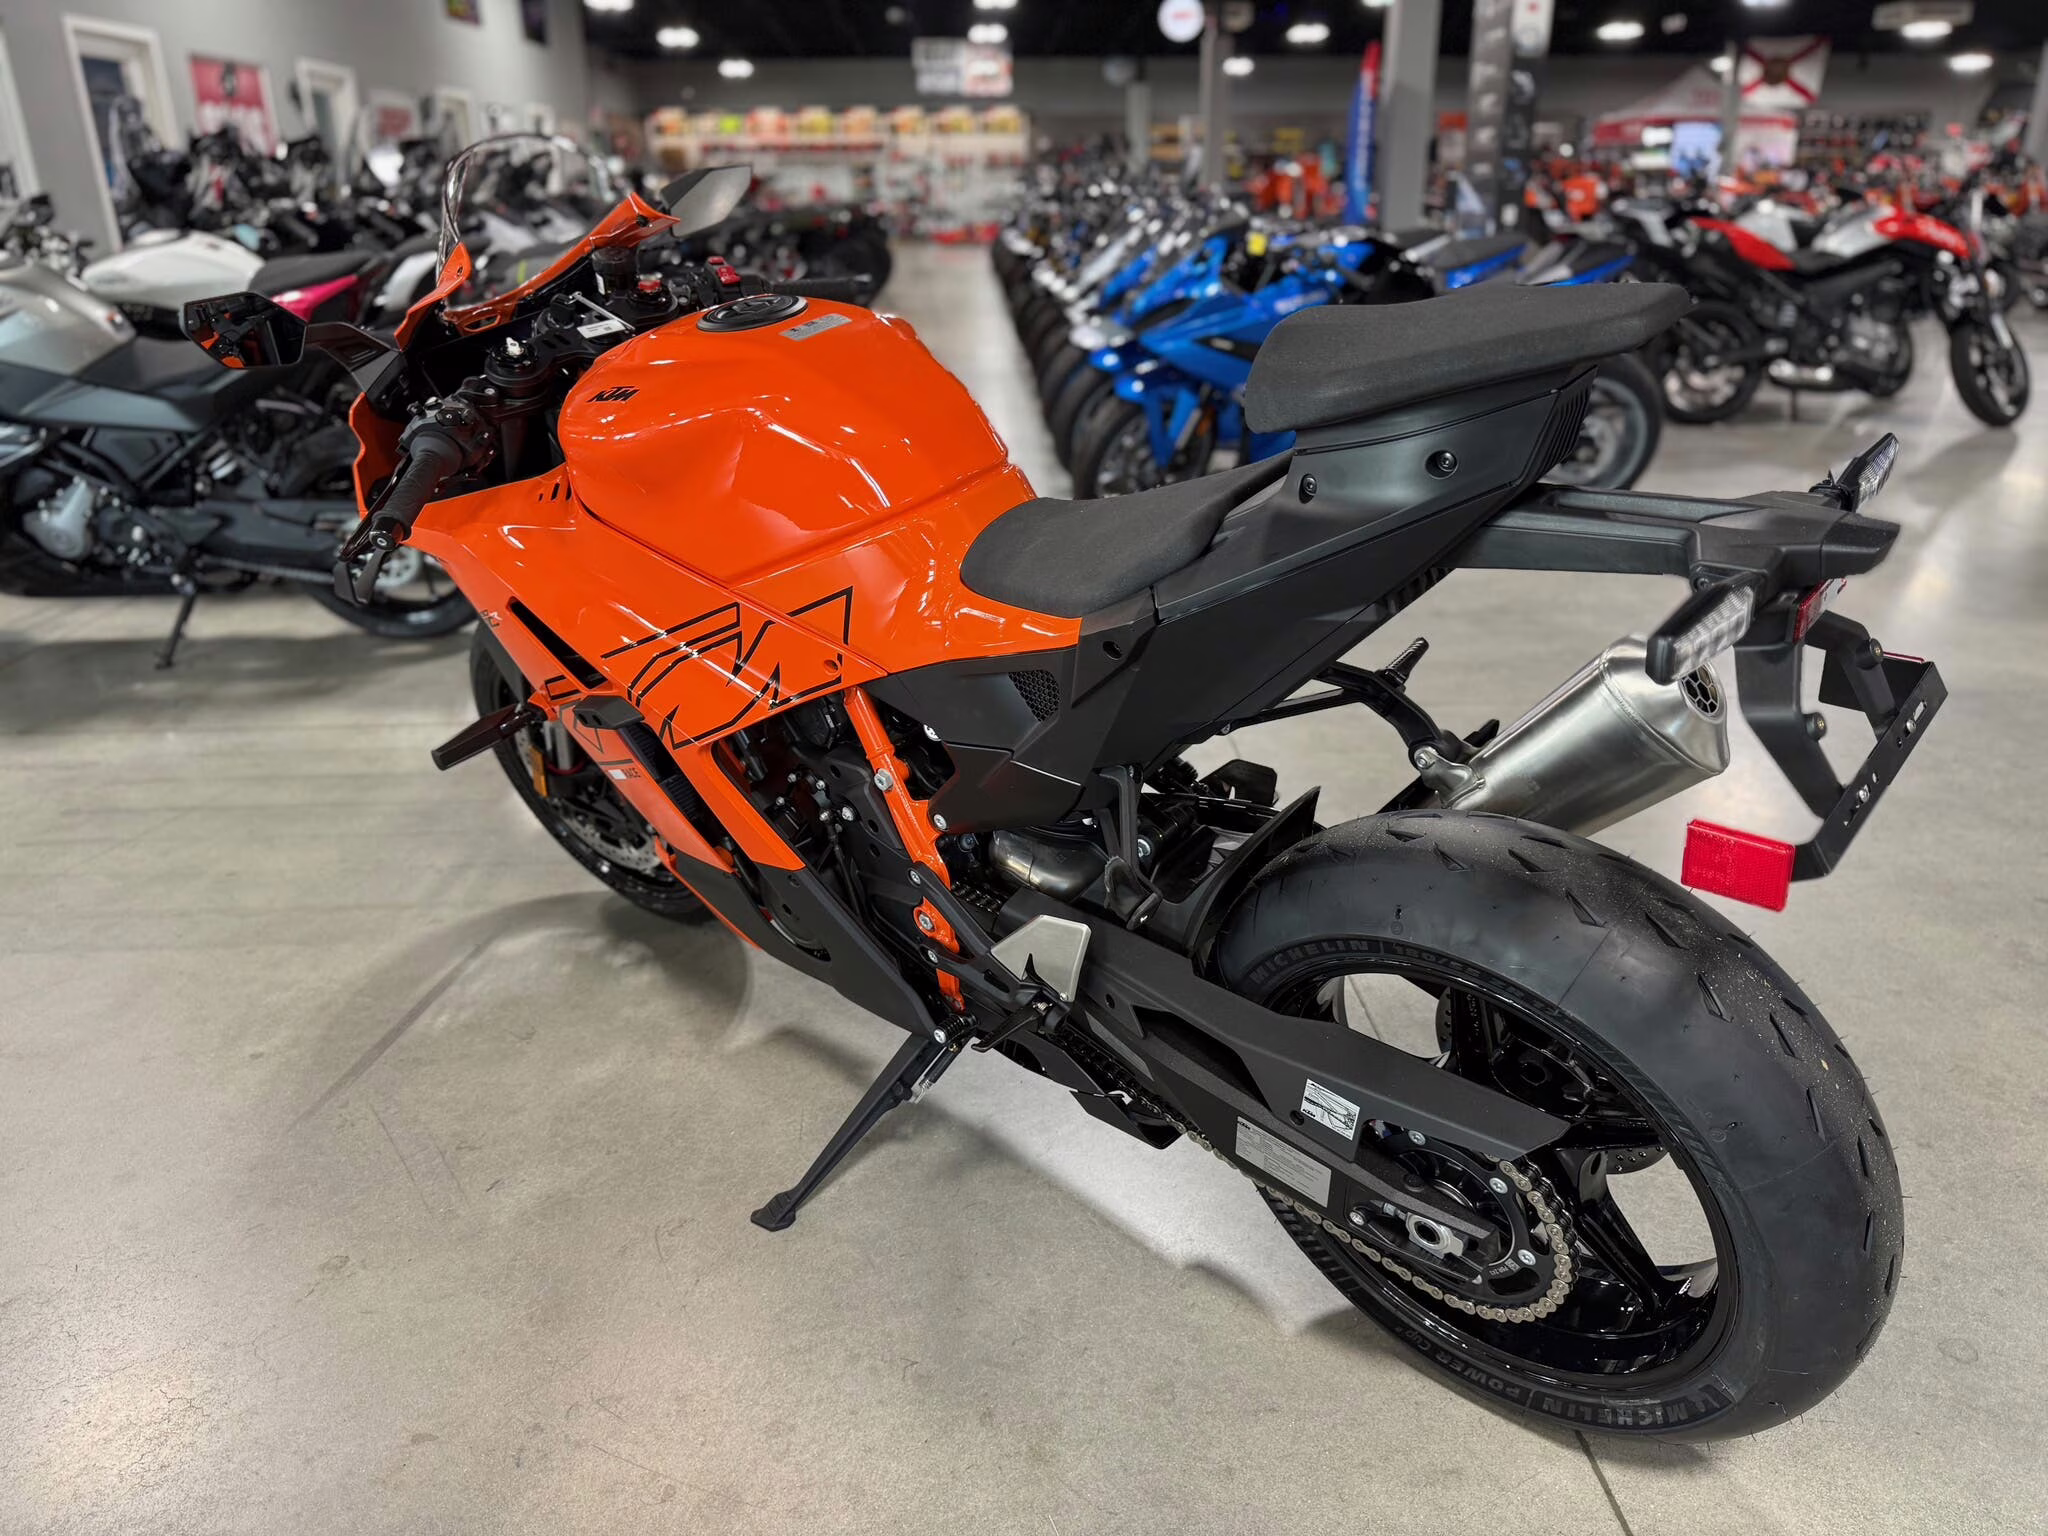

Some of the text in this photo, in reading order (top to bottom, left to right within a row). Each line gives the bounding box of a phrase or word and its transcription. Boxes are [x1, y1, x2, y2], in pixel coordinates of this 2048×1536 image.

[587, 386, 640, 403] KTM
[1249, 940, 1369, 984] MICHELIN
[1435, 1350, 1520, 1398] POWER
[1542, 1396, 1688, 1426] MICHELIN
